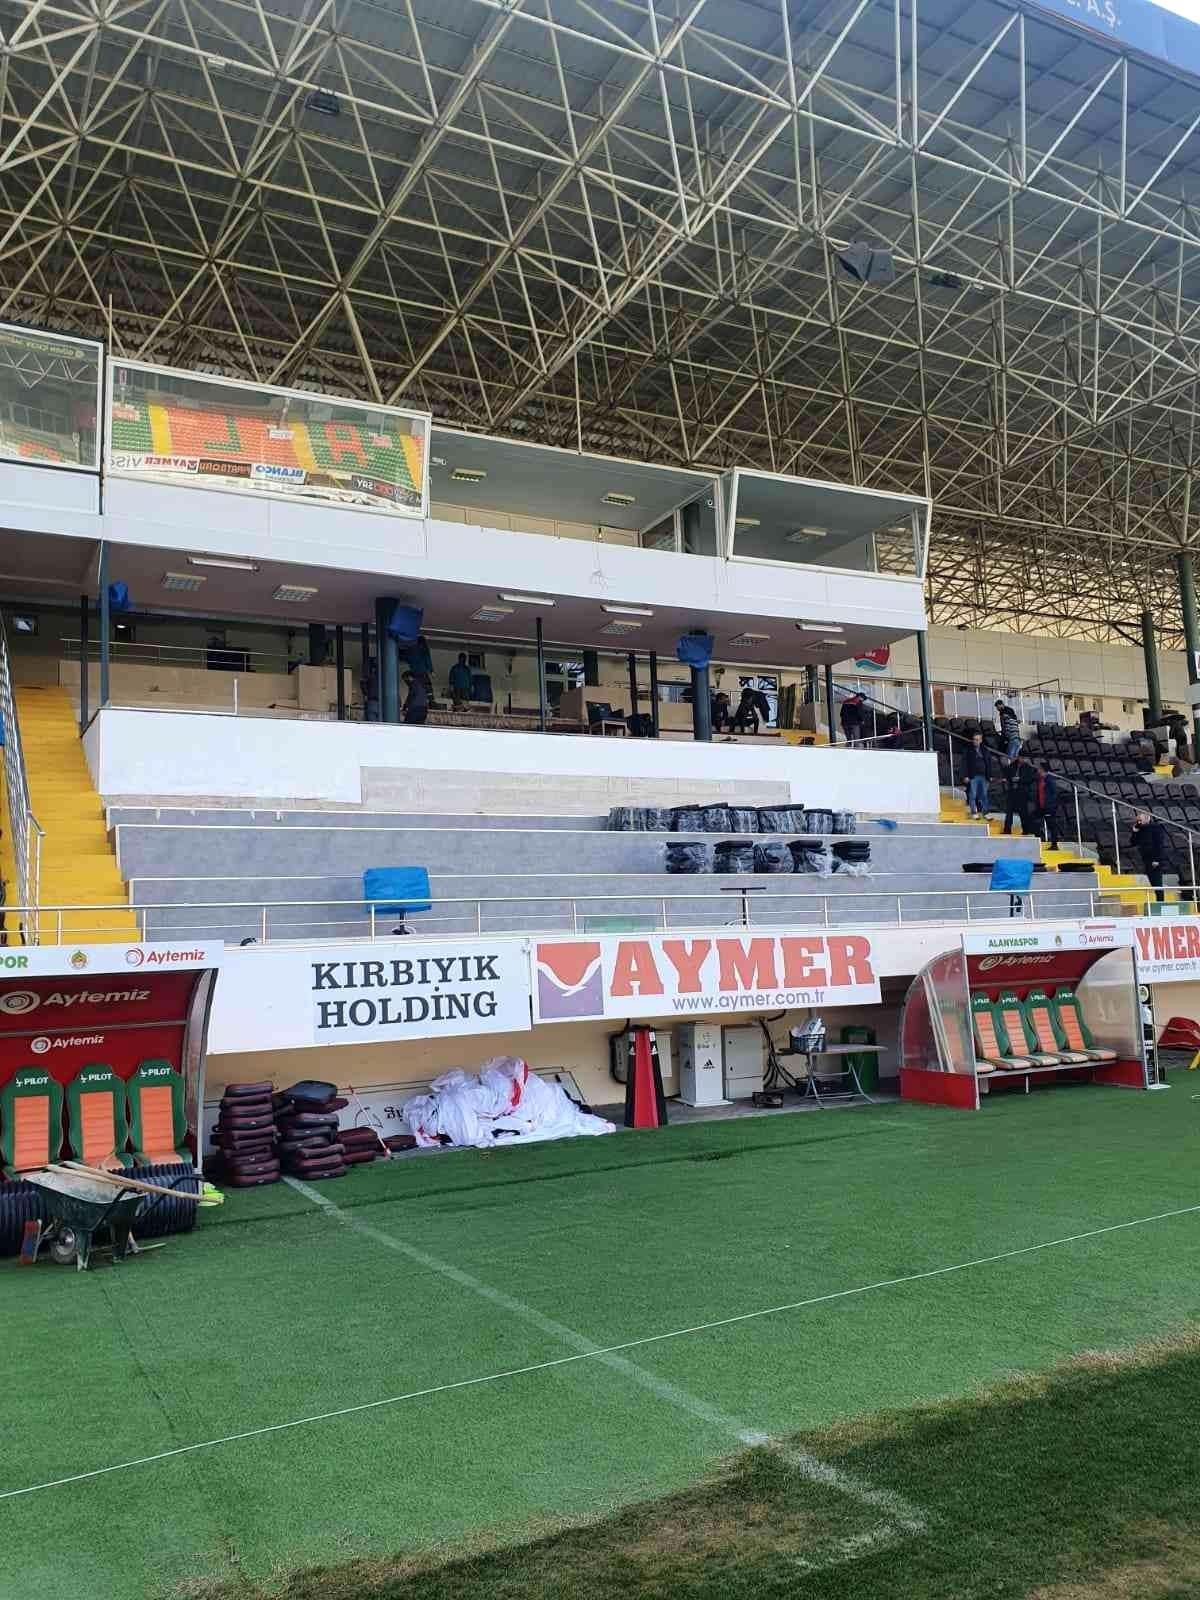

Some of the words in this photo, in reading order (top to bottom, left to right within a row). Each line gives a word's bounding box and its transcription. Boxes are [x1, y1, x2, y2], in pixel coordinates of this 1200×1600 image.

[988, 936, 1041, 948] ALANYASPOR
[147, 950, 205, 965] Aytemiz
[311, 955, 500, 990] KIRBIYIK
[610, 935, 875, 996] AYMER
[43, 989, 151, 1007] Aytemiz
[672, 990, 825, 1011] www.aymer.com.tr
[317, 986, 498, 1028] HOLDİNG
[51, 1034, 104, 1049] Aytemiz
[88, 1073, 113, 1081] PILOT
[148, 1067, 171, 1076] PILOT
[24, 1076, 49, 1085] PILOT
